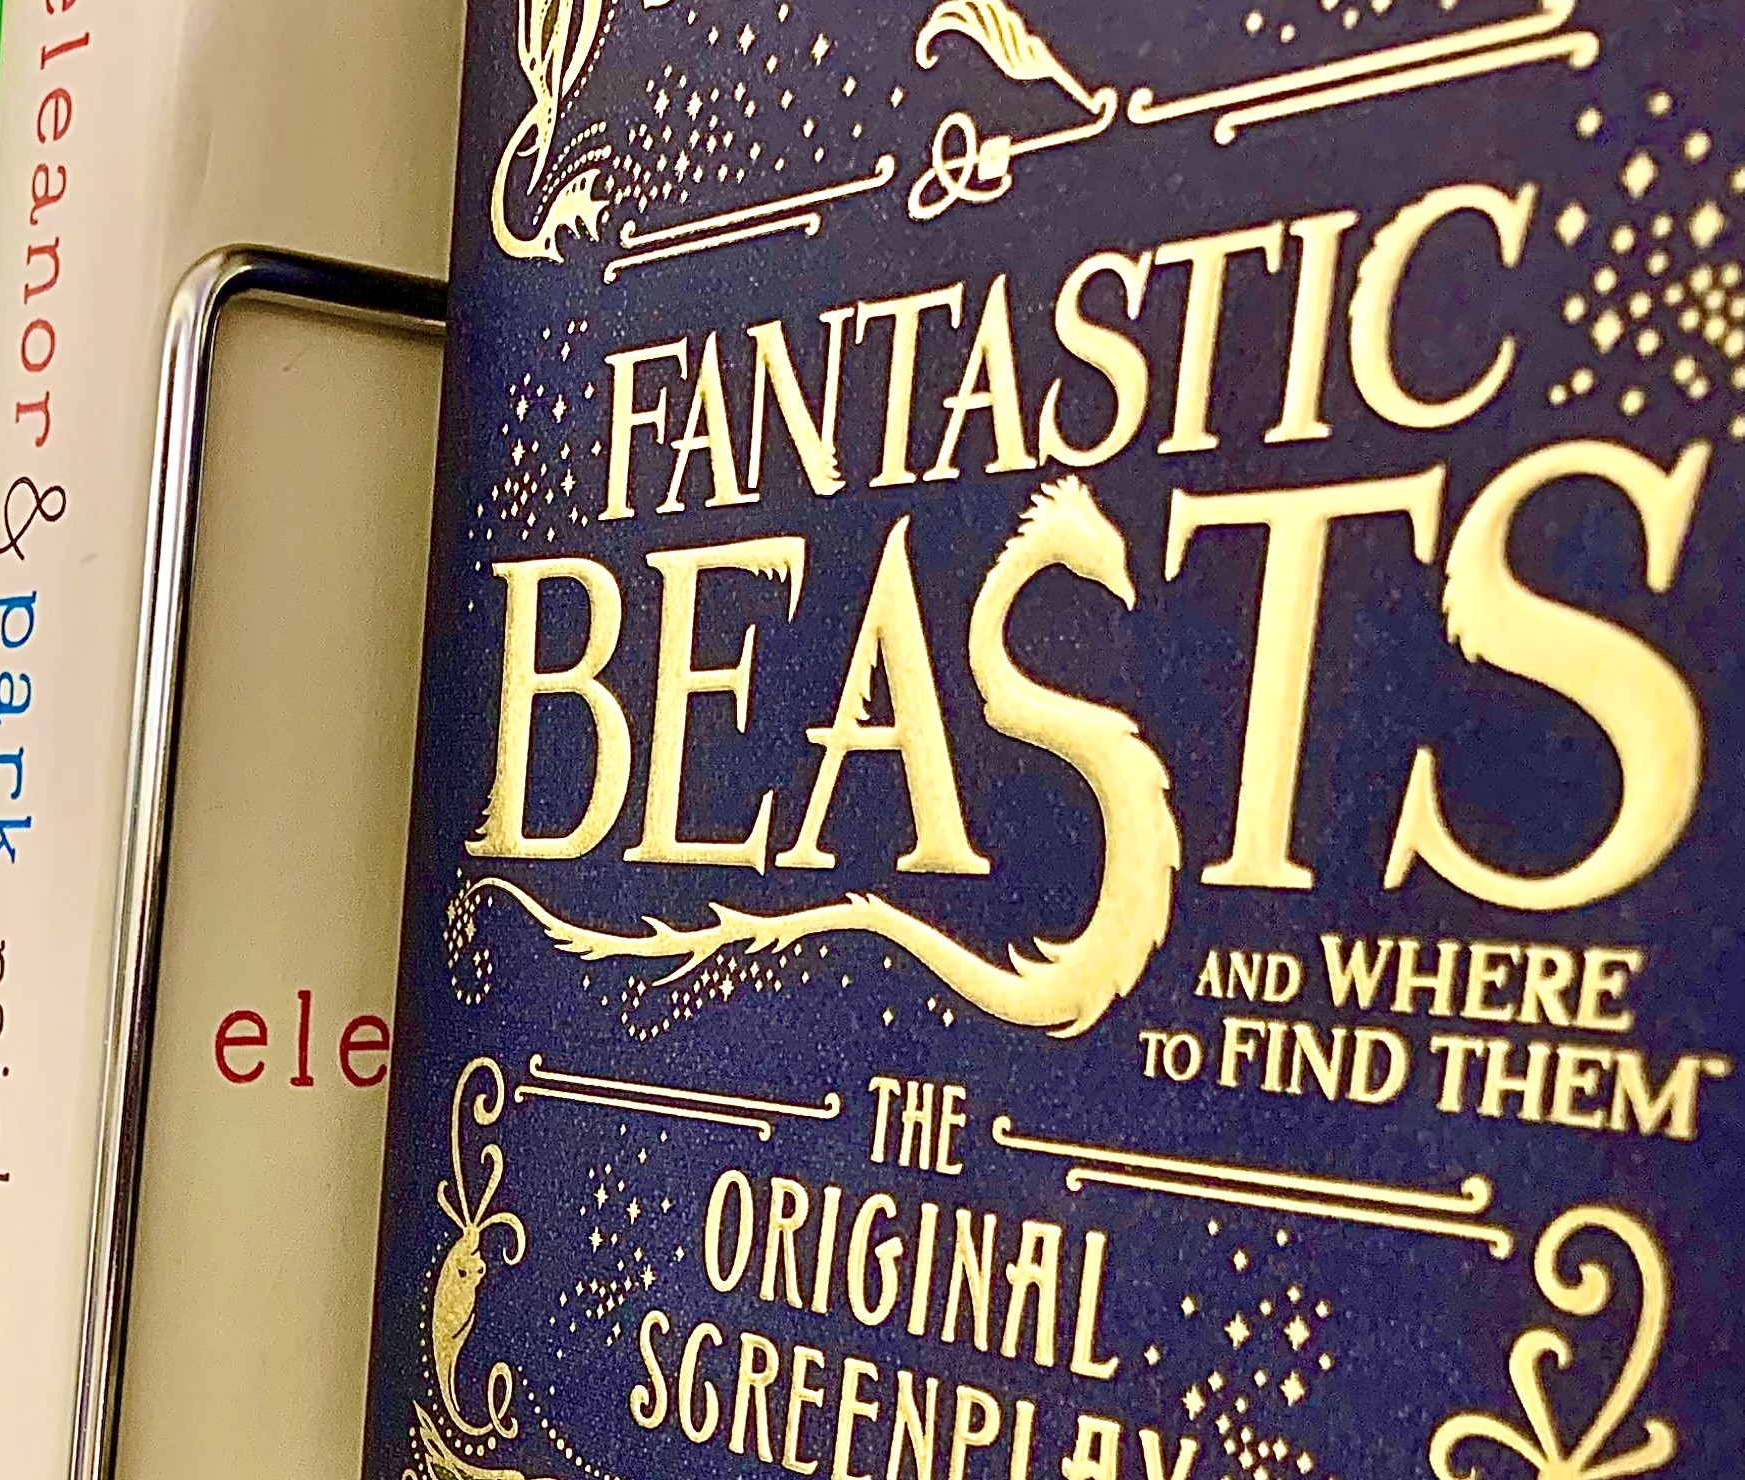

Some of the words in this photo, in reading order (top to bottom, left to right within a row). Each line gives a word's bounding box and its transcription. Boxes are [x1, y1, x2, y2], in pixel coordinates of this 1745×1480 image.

[597, 184, 1538, 522] FANTASTIC
[450, 438, 1715, 1040] BEASTS
[1195, 946, 1303, 1005] AND
[1321, 934, 1645, 1034] WHERE
[213, 989, 390, 1089] ele
[1137, 1028, 1201, 1084] TO
[1219, 1026, 1409, 1106] FIND
[869, 1076, 967, 1176] THE
[703, 1168, 1119, 1380] ORIGINAL
